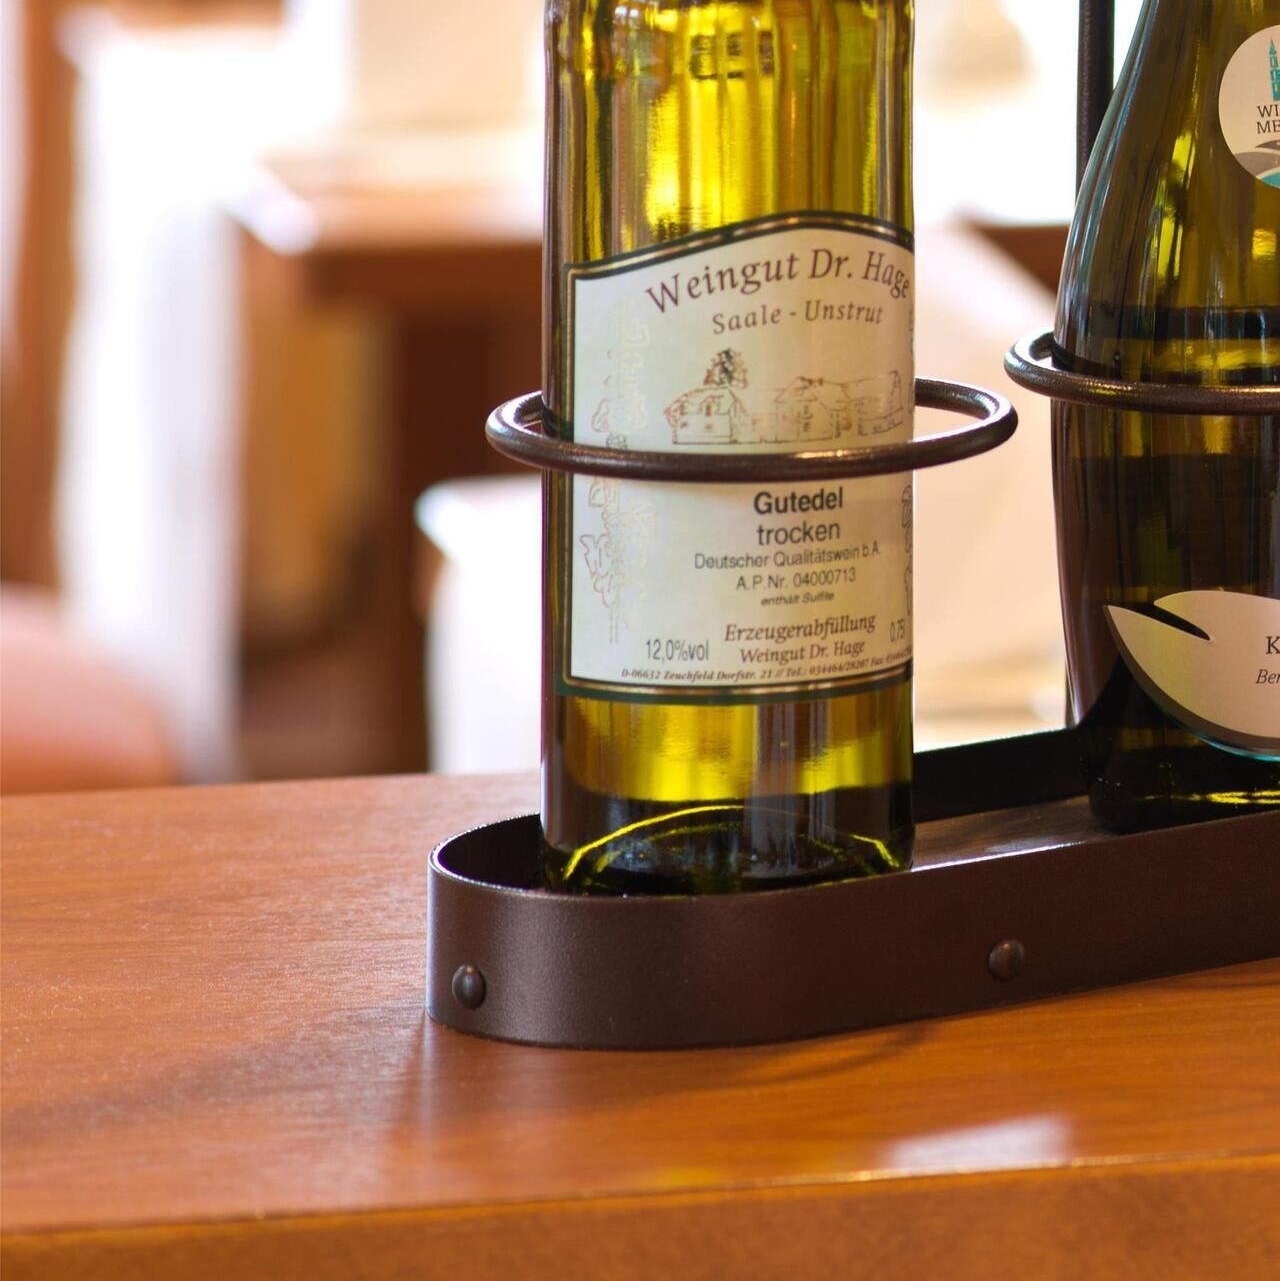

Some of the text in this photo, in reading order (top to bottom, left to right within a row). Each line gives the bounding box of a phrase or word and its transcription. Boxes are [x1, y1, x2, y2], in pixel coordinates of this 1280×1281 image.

[645, 248, 911, 314] Weingut Dr. Hage
[712, 305, 781, 335] Saale
[805, 299, 884, 324] Unstrut
[753, 487, 844, 515] Gutedel
[756, 520, 841, 547] trocken
[694, 552, 769, 569] Deutscher
[773, 544, 860, 568] Qualitätswein
[792, 567, 857, 588] 04000713
[724, 615, 876, 644] Erzeugerabfüllung
[645, 638, 710, 664] 12,0%vol
[740, 647, 804, 666] Weingut
[809, 644, 828, 659] Dr.
[834, 641, 865, 657] Hage
